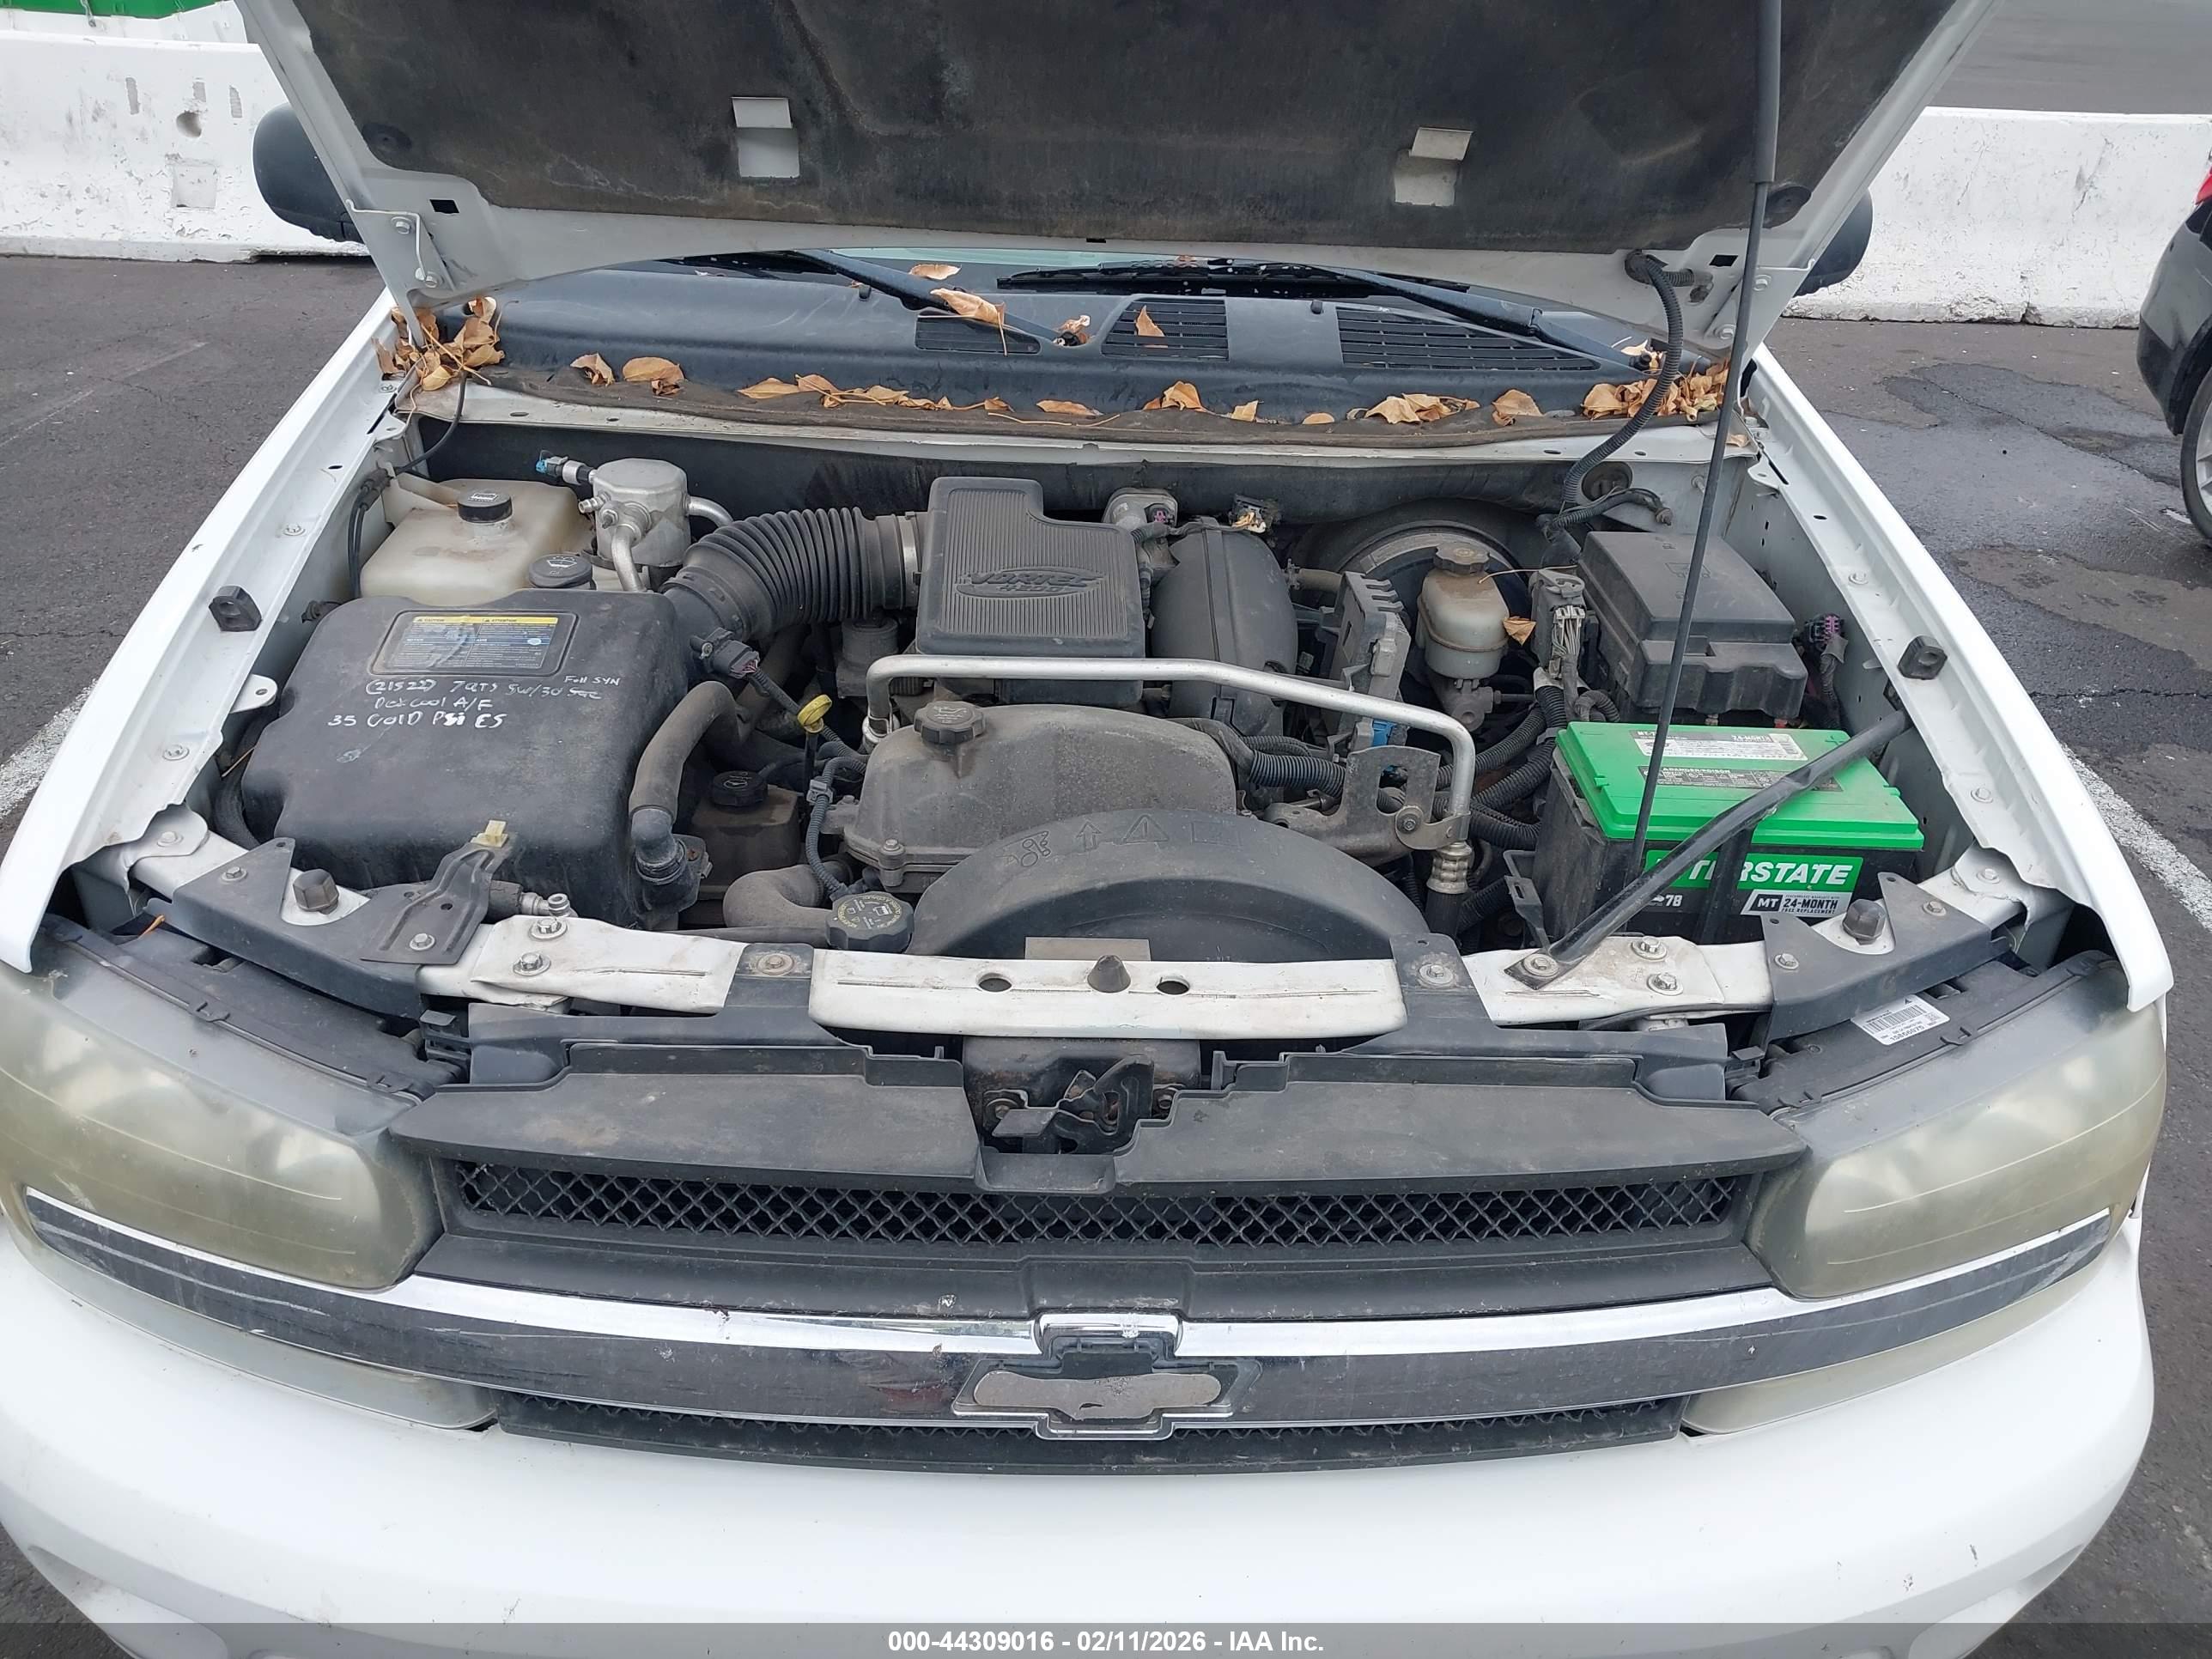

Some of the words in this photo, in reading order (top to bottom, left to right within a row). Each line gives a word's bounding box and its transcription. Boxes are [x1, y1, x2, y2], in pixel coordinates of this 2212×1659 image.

[592, 676, 620, 686] SYN
[453, 696, 494, 712] A/F
[327, 714, 357, 726] 35
[1757, 898, 1780, 908] MT
[1783, 898, 1838, 909] 24-MONTH
